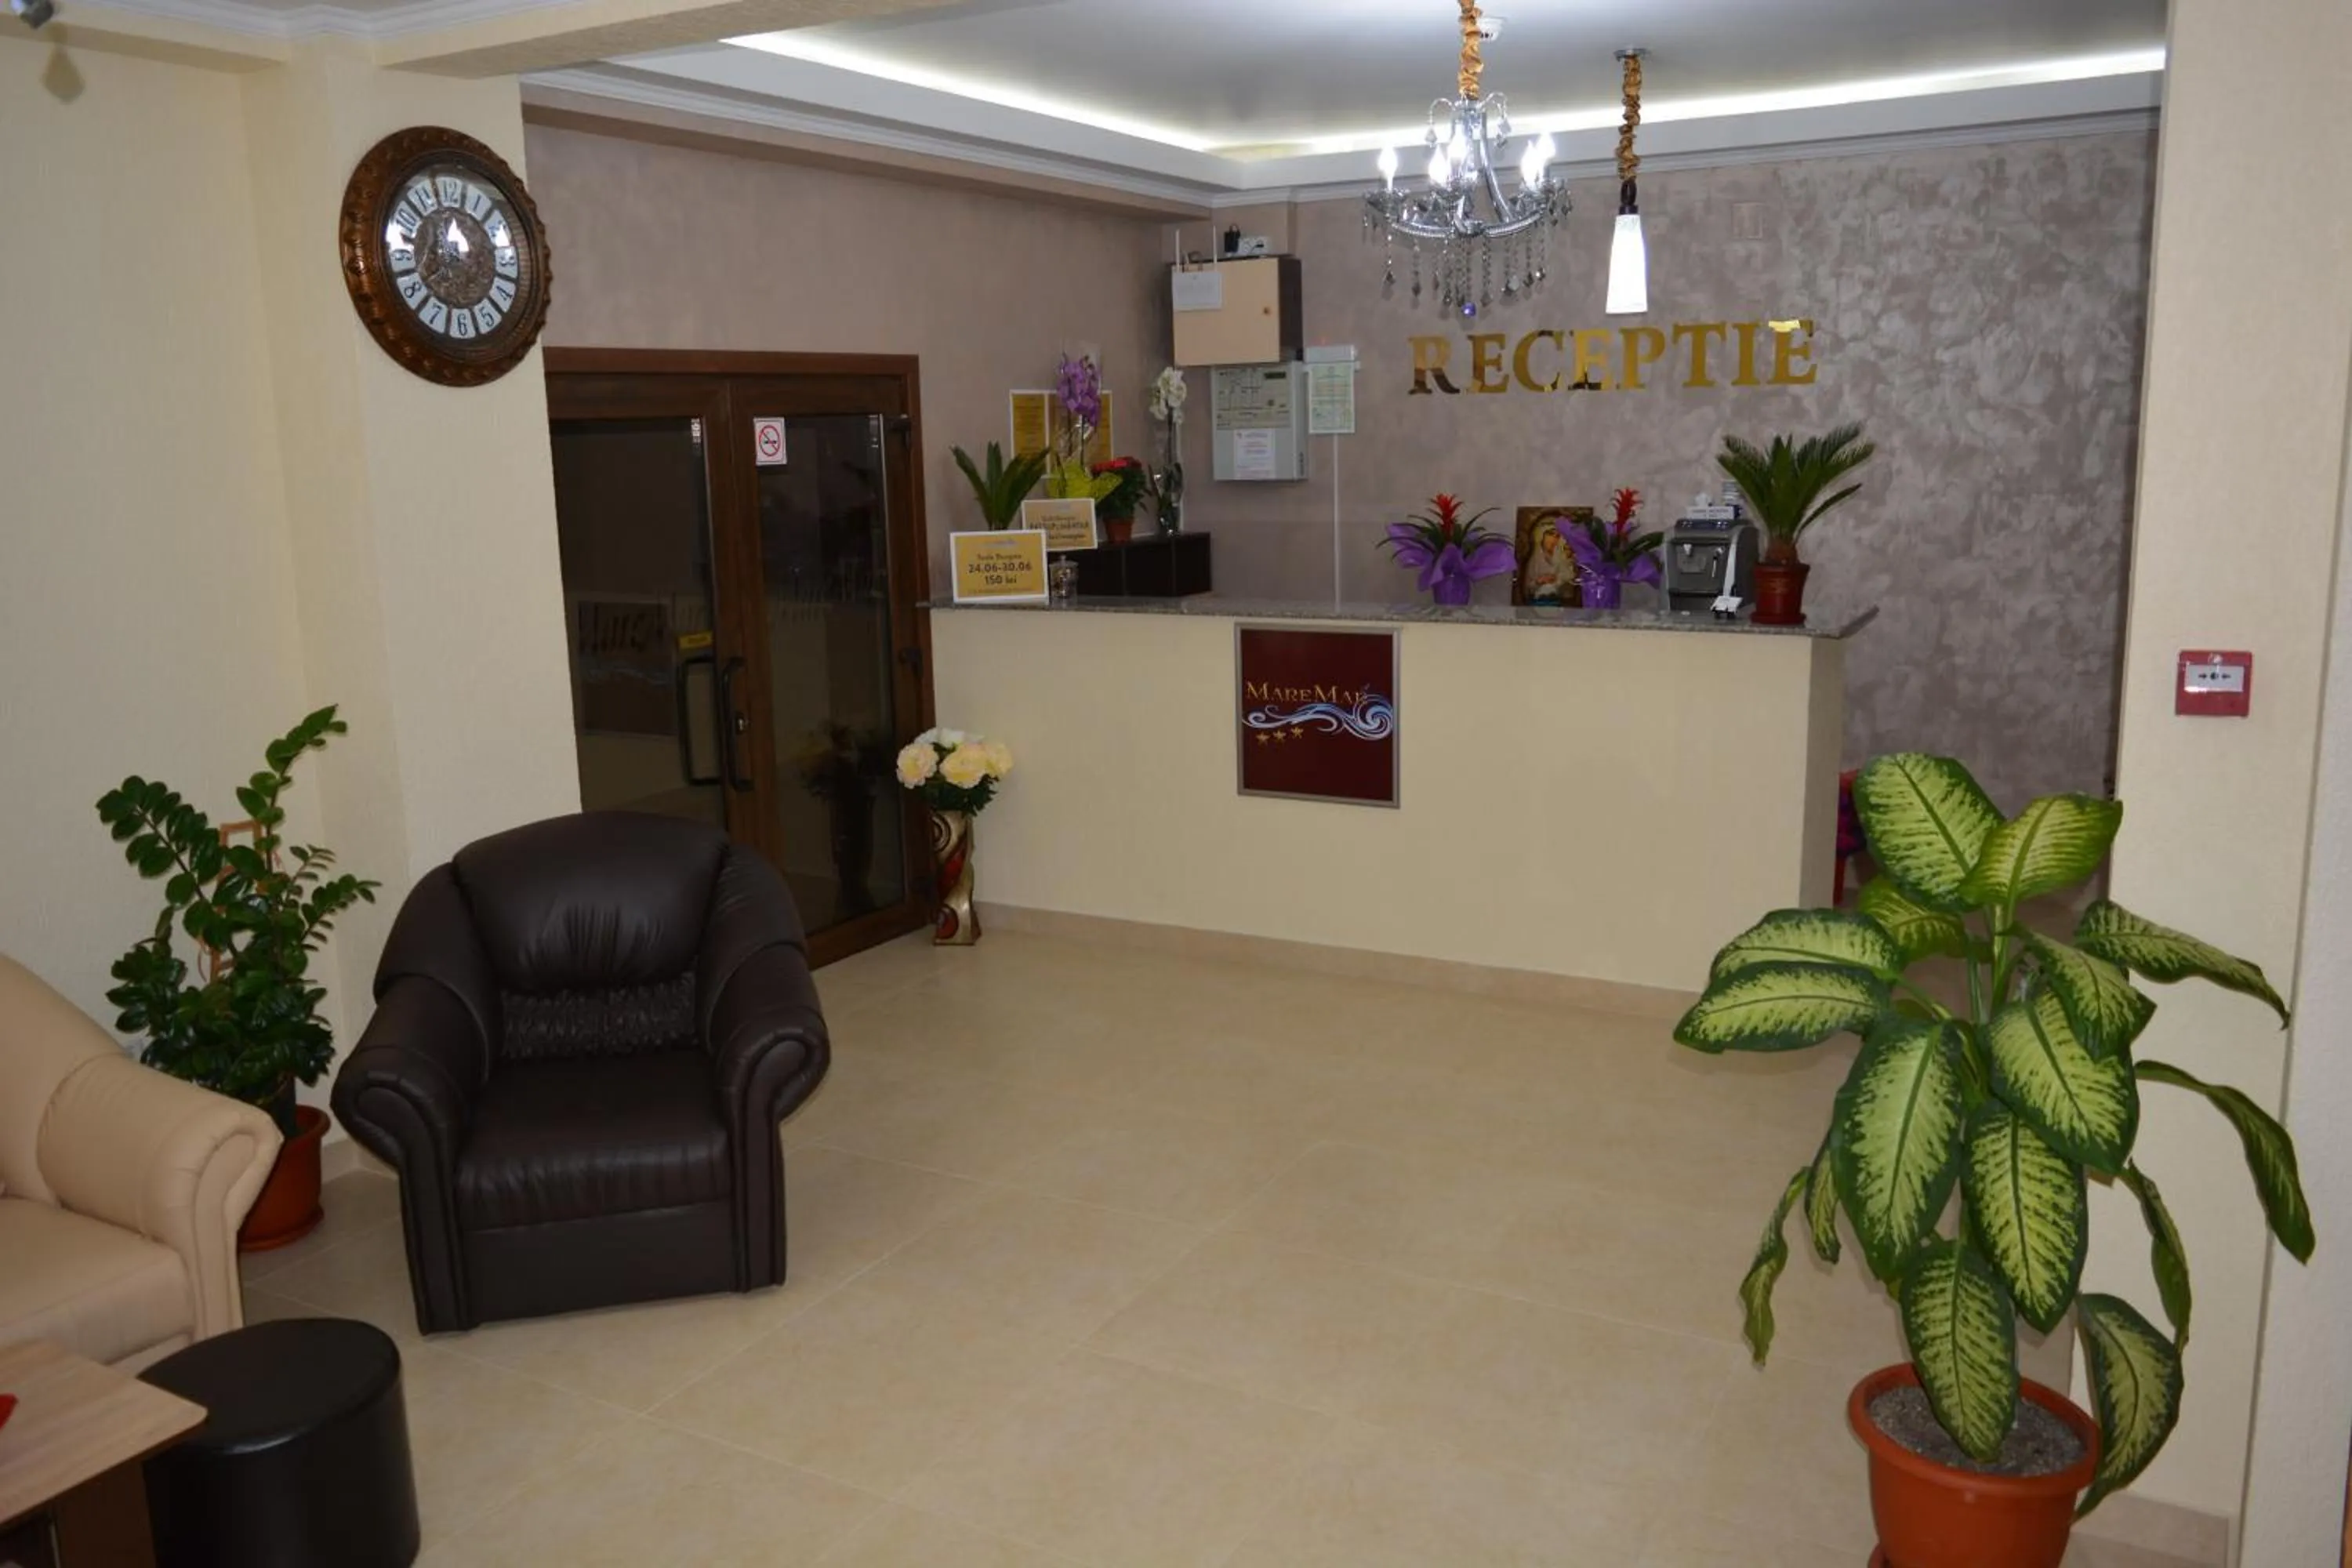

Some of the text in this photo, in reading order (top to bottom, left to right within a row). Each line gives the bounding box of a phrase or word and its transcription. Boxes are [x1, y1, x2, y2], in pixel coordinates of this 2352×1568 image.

[413, 185, 434, 213] 11
[443, 180, 459, 204] 12
[473, 194, 481, 212] 1
[396, 208, 417, 234] 10
[392, 249, 412, 262] 9
[498, 255, 516, 267] 3
[404, 281, 422, 299] 8
[495, 285, 514, 302] 4
[429, 303, 442, 325] 7
[479, 306, 495, 328] 5
[457, 313, 468, 336] 6
[1407, 319, 1818, 395] RECEPTIE
[968, 561, 1033, 574] 24.06-30.06
[985, 574, 1003, 585] 150
